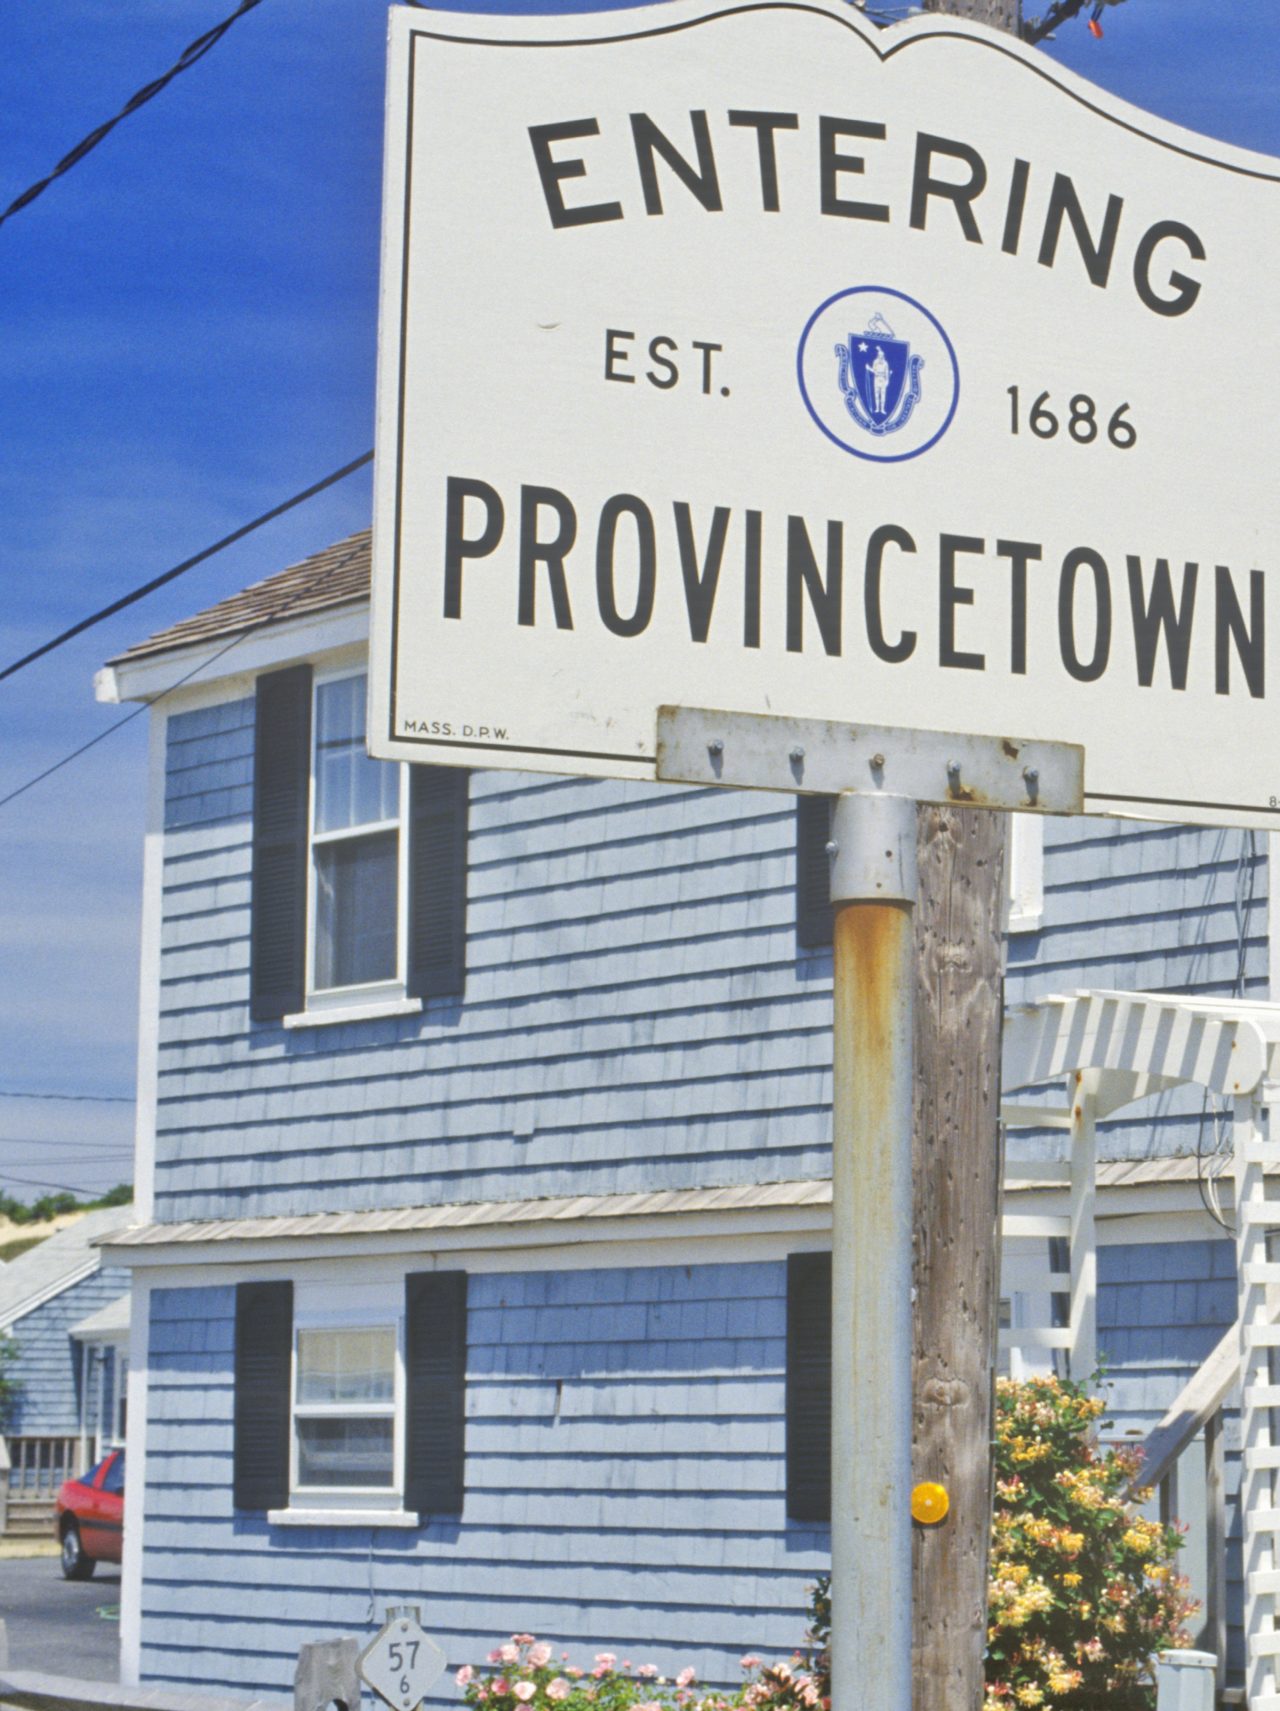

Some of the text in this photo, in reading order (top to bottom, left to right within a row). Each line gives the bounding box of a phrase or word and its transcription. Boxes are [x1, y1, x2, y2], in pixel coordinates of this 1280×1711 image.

[528, 109, 1208, 317] ENTERING
[604, 328, 731, 397] EST.
[1006, 385, 1138, 450] 1686
[443, 475, 1265, 700] PROVINCETOWN
[404, 720, 456, 736] MASS.
[388, 1640, 420, 1672] 57
[400, 1674, 410, 1694] 6
